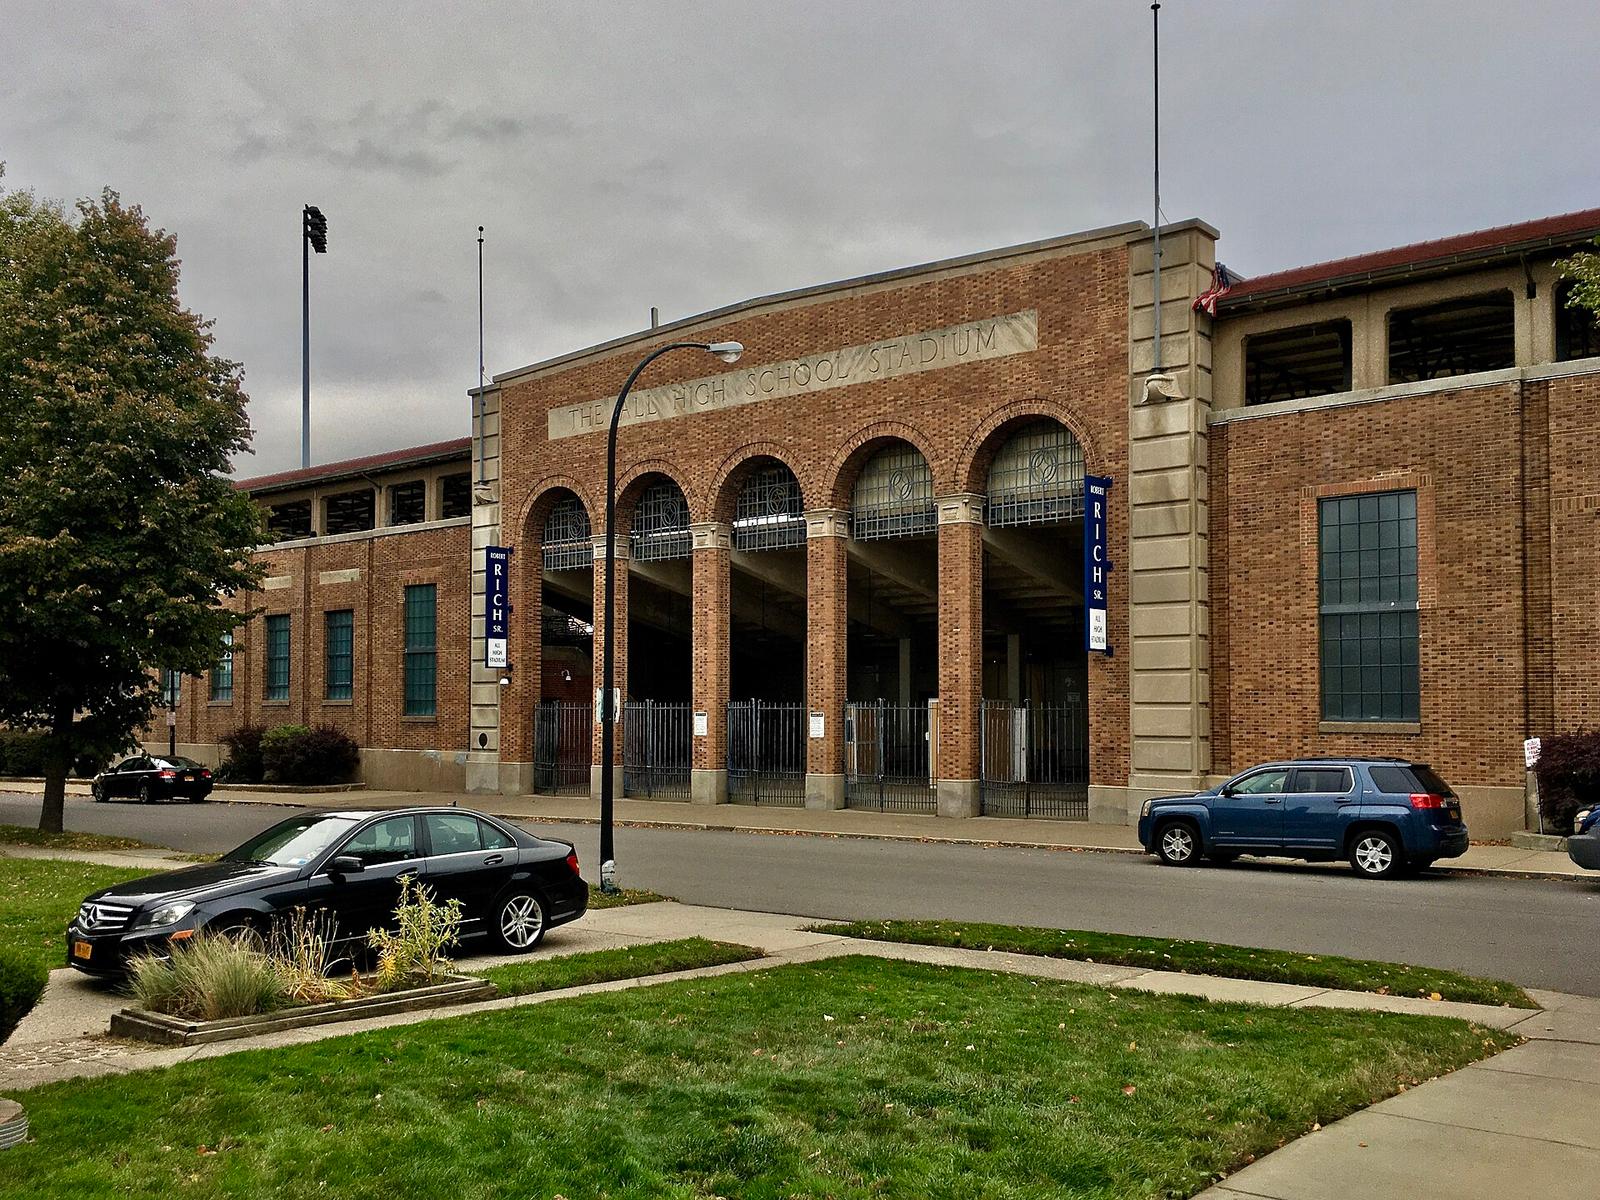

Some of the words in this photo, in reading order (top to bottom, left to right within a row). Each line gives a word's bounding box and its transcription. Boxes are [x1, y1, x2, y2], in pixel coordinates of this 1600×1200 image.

[568, 404, 604, 431] THE
[673, 379, 725, 410] HIGH
[745, 356, 849, 396] SCHOOL
[868, 323, 997, 374] STADIUM
[1093, 501, 1102, 584] RICH
[493, 563, 502, 621] RICH
